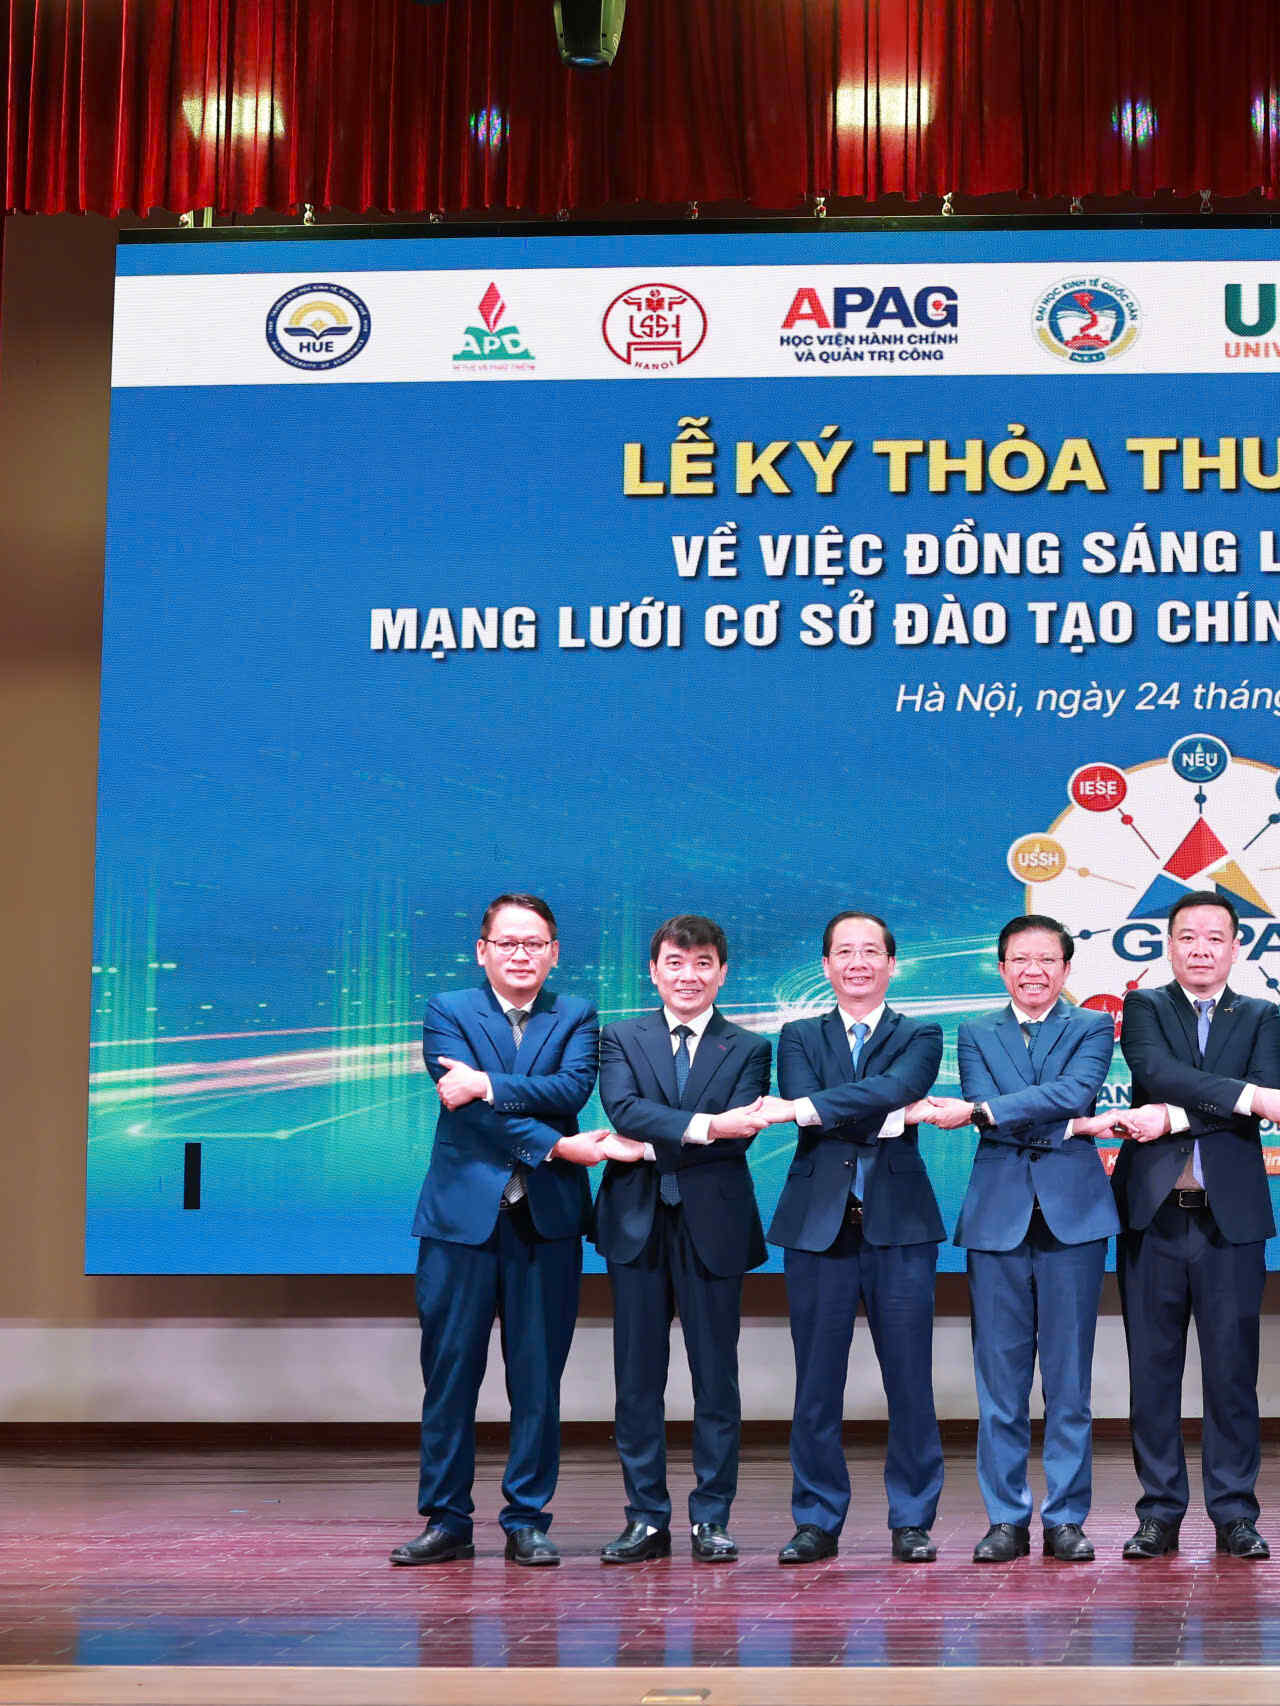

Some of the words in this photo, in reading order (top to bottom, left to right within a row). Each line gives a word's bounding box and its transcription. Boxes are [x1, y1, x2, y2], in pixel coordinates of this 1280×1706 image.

[1062, 280, 1086, 290] KINH
[1089, 278, 1100, 287] TẾ
[781, 286, 958, 329] APAG
[299, 341, 335, 353] HUE
[456, 334, 528, 356] APD
[780, 335, 815, 348] HỌC
[817, 332, 856, 347] VIỆN
[859, 332, 904, 346] HÀNH
[907, 331, 958, 345] CHÍNH
[795, 348, 816, 362] VÀ
[819, 347, 865, 364] QUẢN
[868, 350, 895, 363] TRỊ
[898, 347, 944, 361] CÔNG
[635, 360, 674, 370] HANOI
[624, 417, 714, 494] LỄ
[736, 426, 852, 493] KÝ
[873, 424, 1106, 491] THỎA
[672, 522, 737, 576] VỀ
[759, 526, 883, 585] VIỆC
[904, 519, 1060, 574] ĐỒNG
[1083, 523, 1237, 573] SÁNG
[371, 607, 536, 658] MẠNG
[559, 597, 681, 648] LƯỚI
[705, 600, 780, 646] CƠ
[800, 589, 874, 645] SỞ
[893, 594, 1006, 645] ĐÀO
[1028, 601, 1133, 652] TẠO
[896, 682, 944, 712] Hà
[957, 682, 1023, 717] Nội,
[1037, 681, 1126, 718] ngày
[1136, 682, 1181, 710] 24
[1182, 753, 1218, 767] NEU
[1080, 781, 1118, 796] IESE
[1018, 853, 1060, 866] USSH
